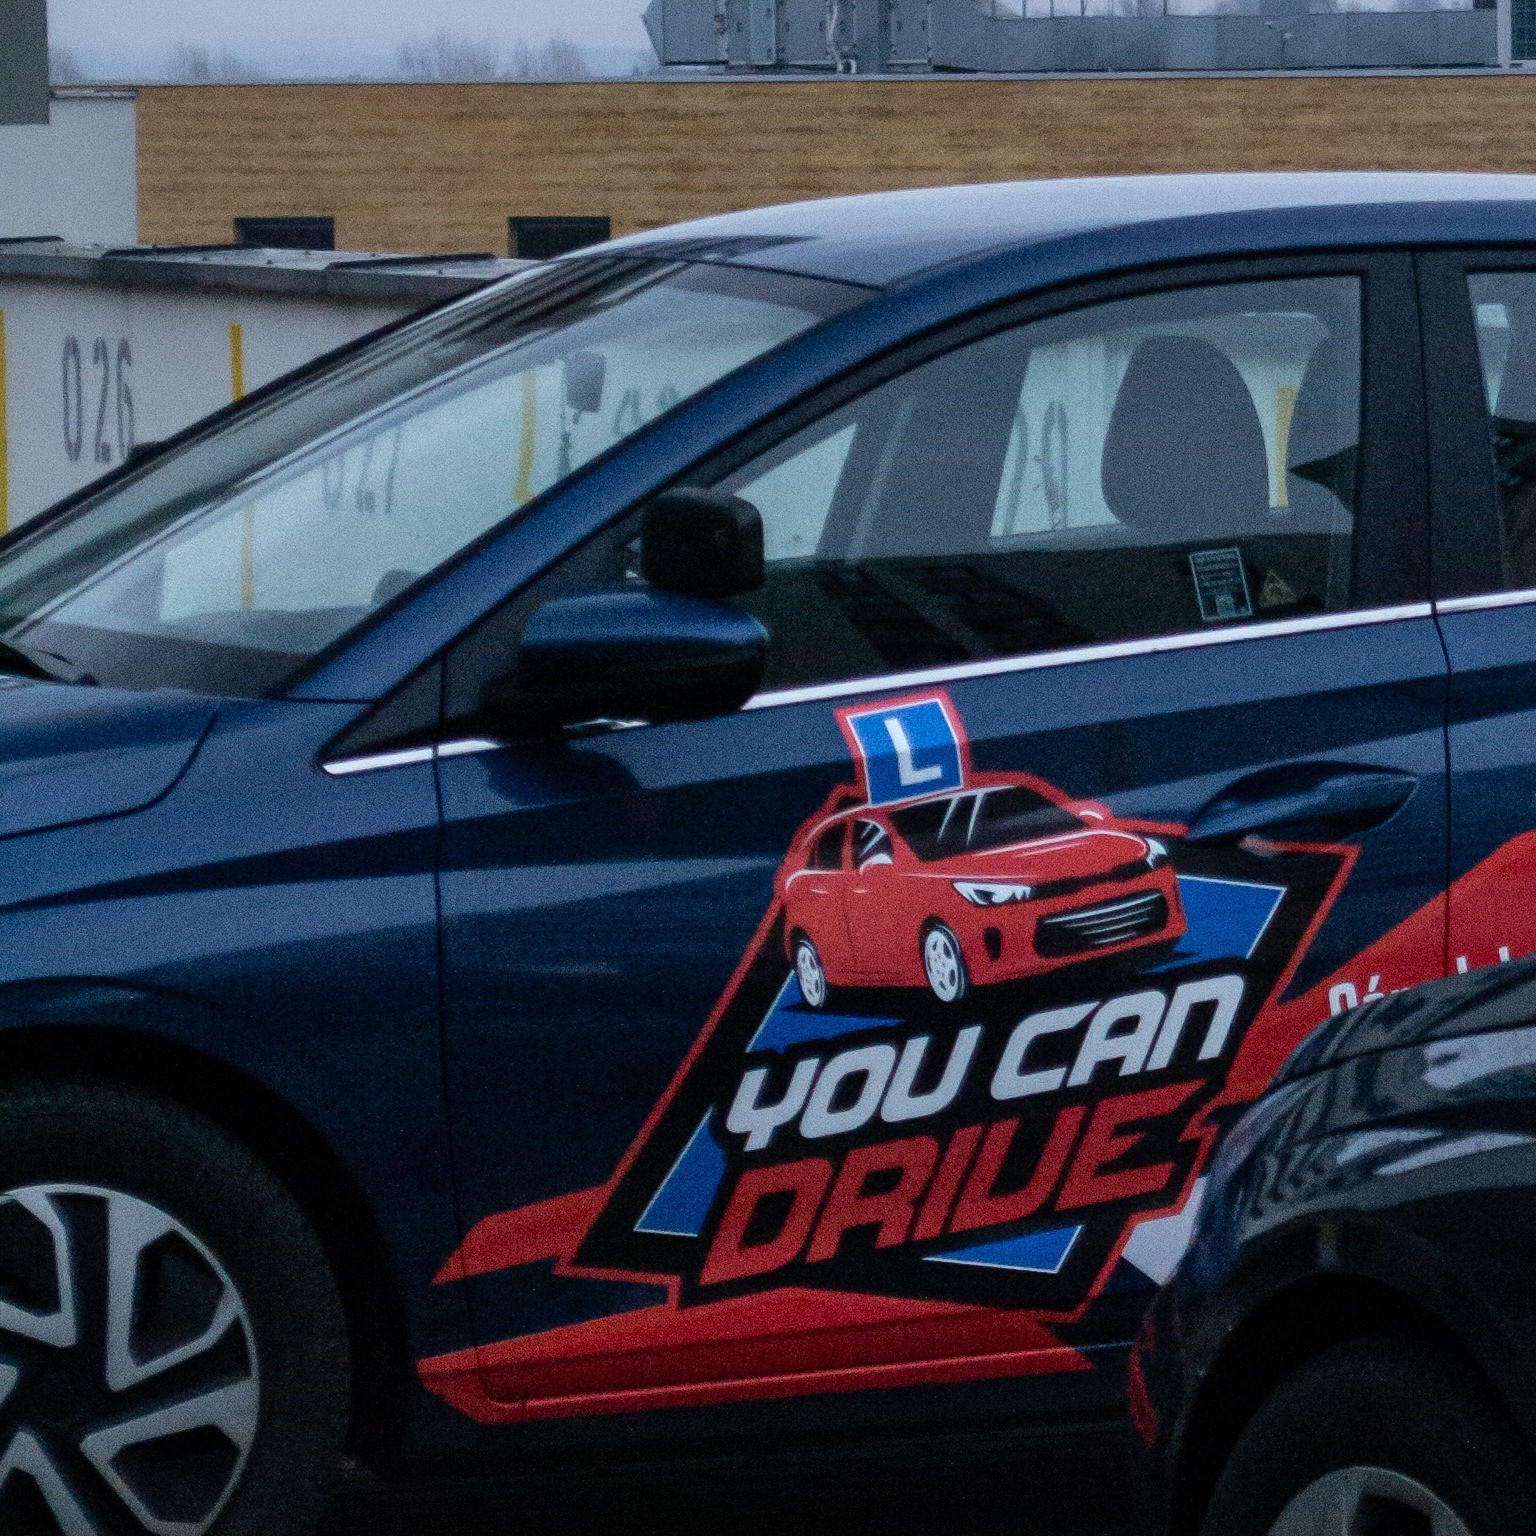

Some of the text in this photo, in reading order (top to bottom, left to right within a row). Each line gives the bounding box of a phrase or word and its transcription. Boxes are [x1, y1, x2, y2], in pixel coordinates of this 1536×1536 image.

[884, 717, 943, 786] L
[725, 1026, 982, 1152] YOU
[990, 974, 1246, 1100] CAN
